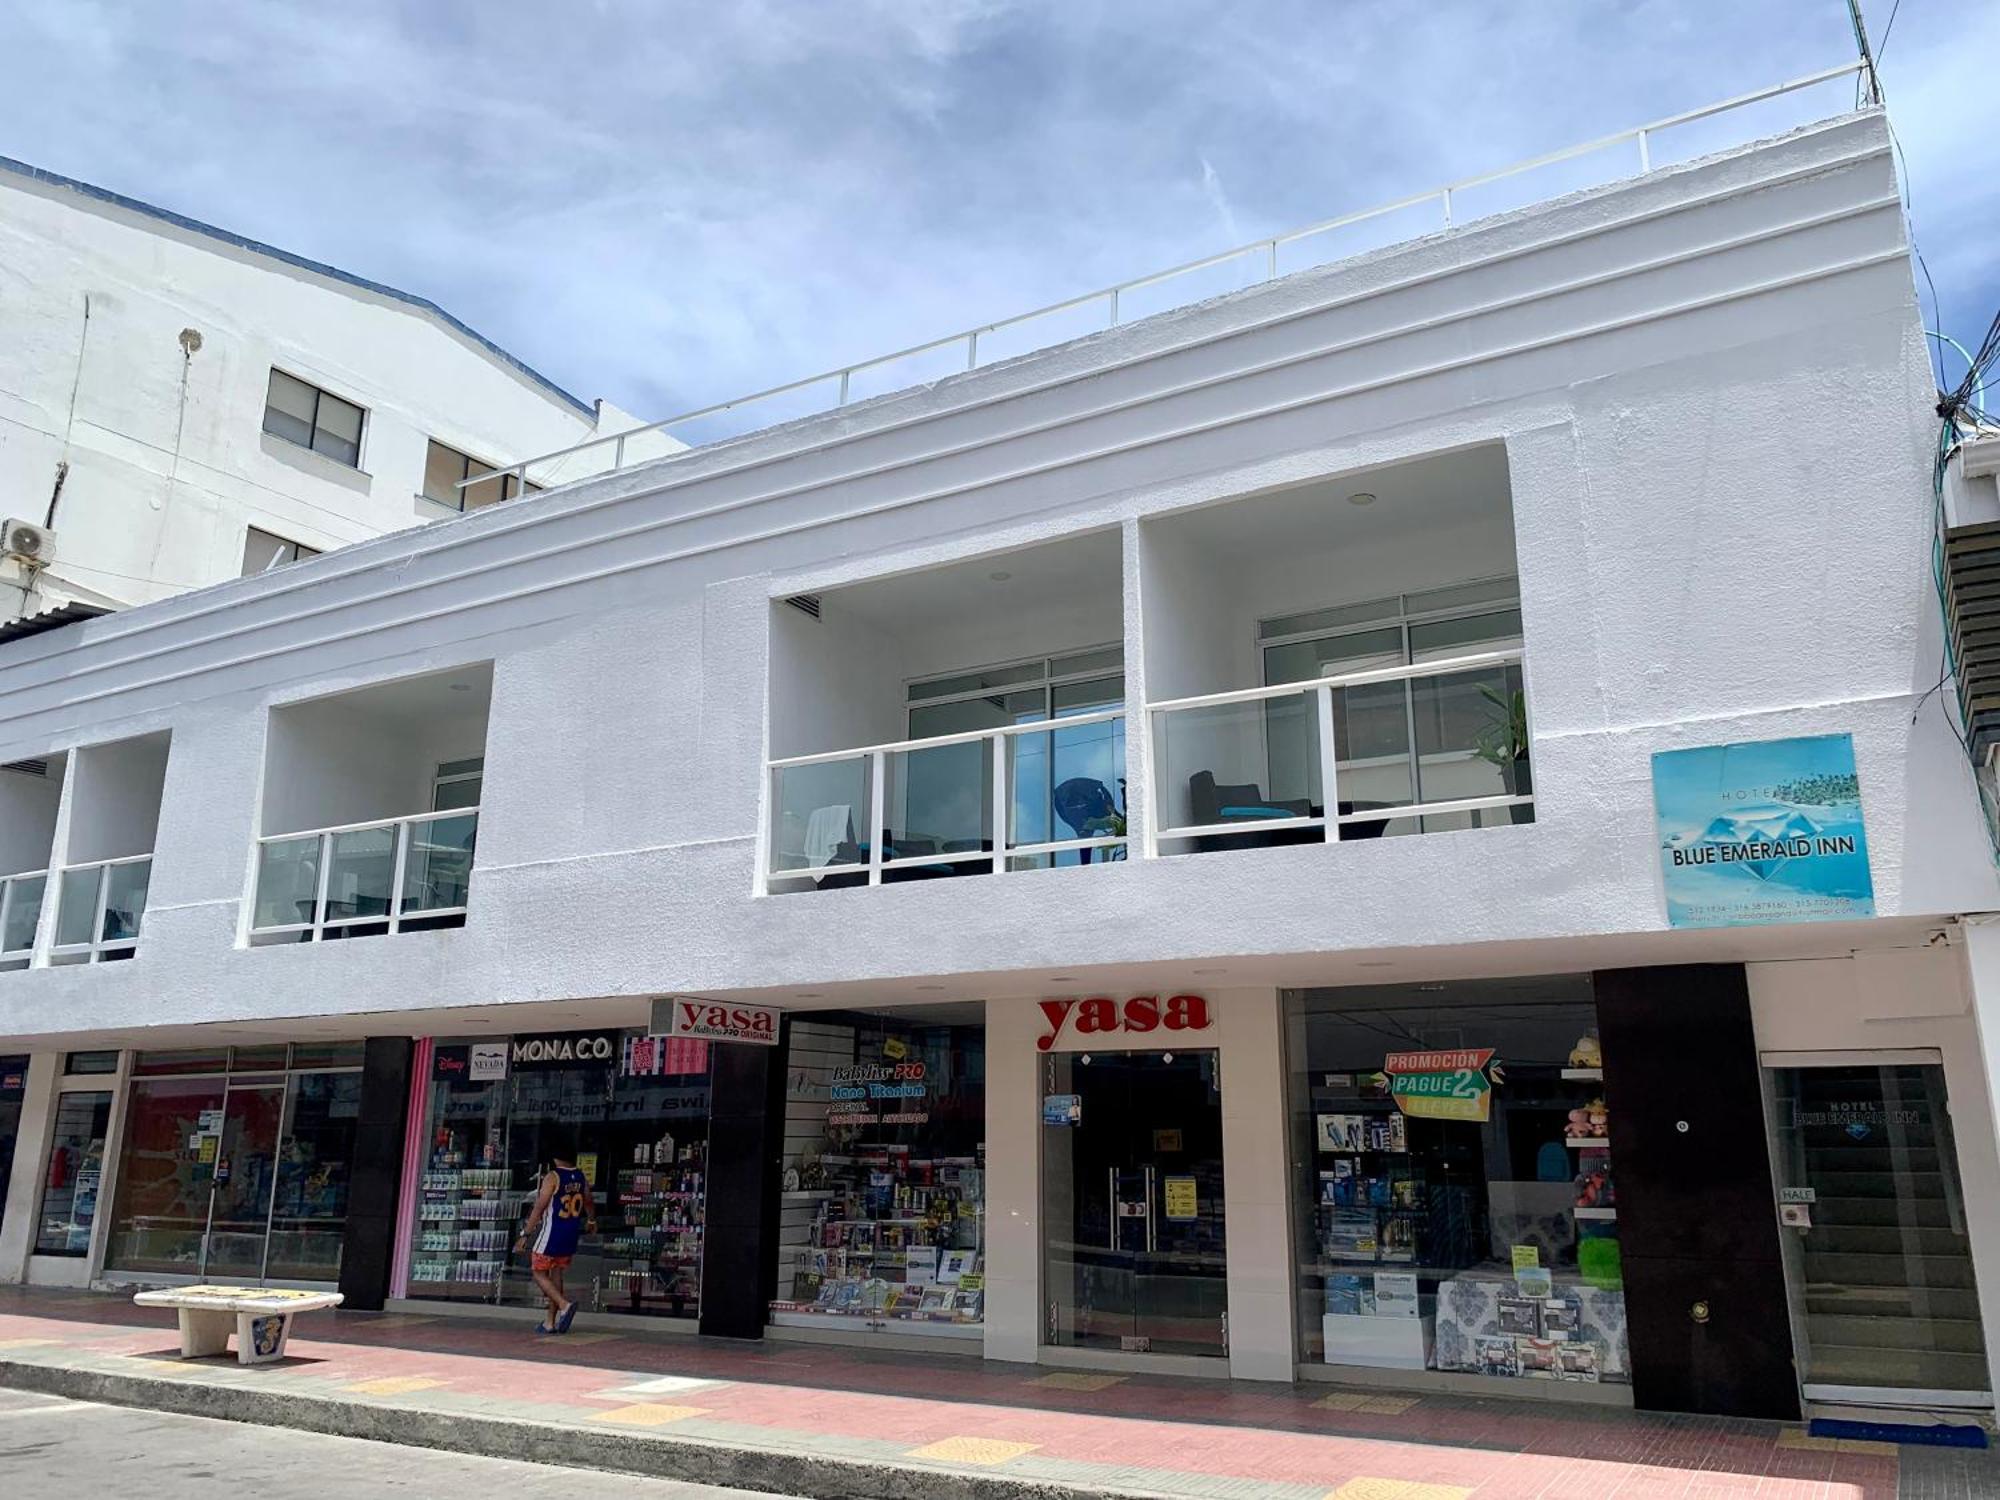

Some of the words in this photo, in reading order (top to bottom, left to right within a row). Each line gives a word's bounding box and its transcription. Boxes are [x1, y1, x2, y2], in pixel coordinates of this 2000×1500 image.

[1673, 846, 1716, 866] BLUE
[1721, 839, 1811, 862] EMERALD
[1816, 836, 1855, 856] INN
[679, 1003, 777, 1033] yasa
[1037, 995, 1213, 1051] yasa
[512, 1037, 610, 1062] MONACO
[894, 1062, 926, 1079] PRO
[1396, 1076, 1453, 1092] PAGUE
[1451, 1068, 1473, 1096] 2
[832, 1086, 866, 1099] Nano
[869, 1084, 926, 1098] Titanium
[1830, 1101, 1876, 1112] HOTEL
[559, 1193, 583, 1218] 30
[1782, 1190, 1812, 1200] HALE
